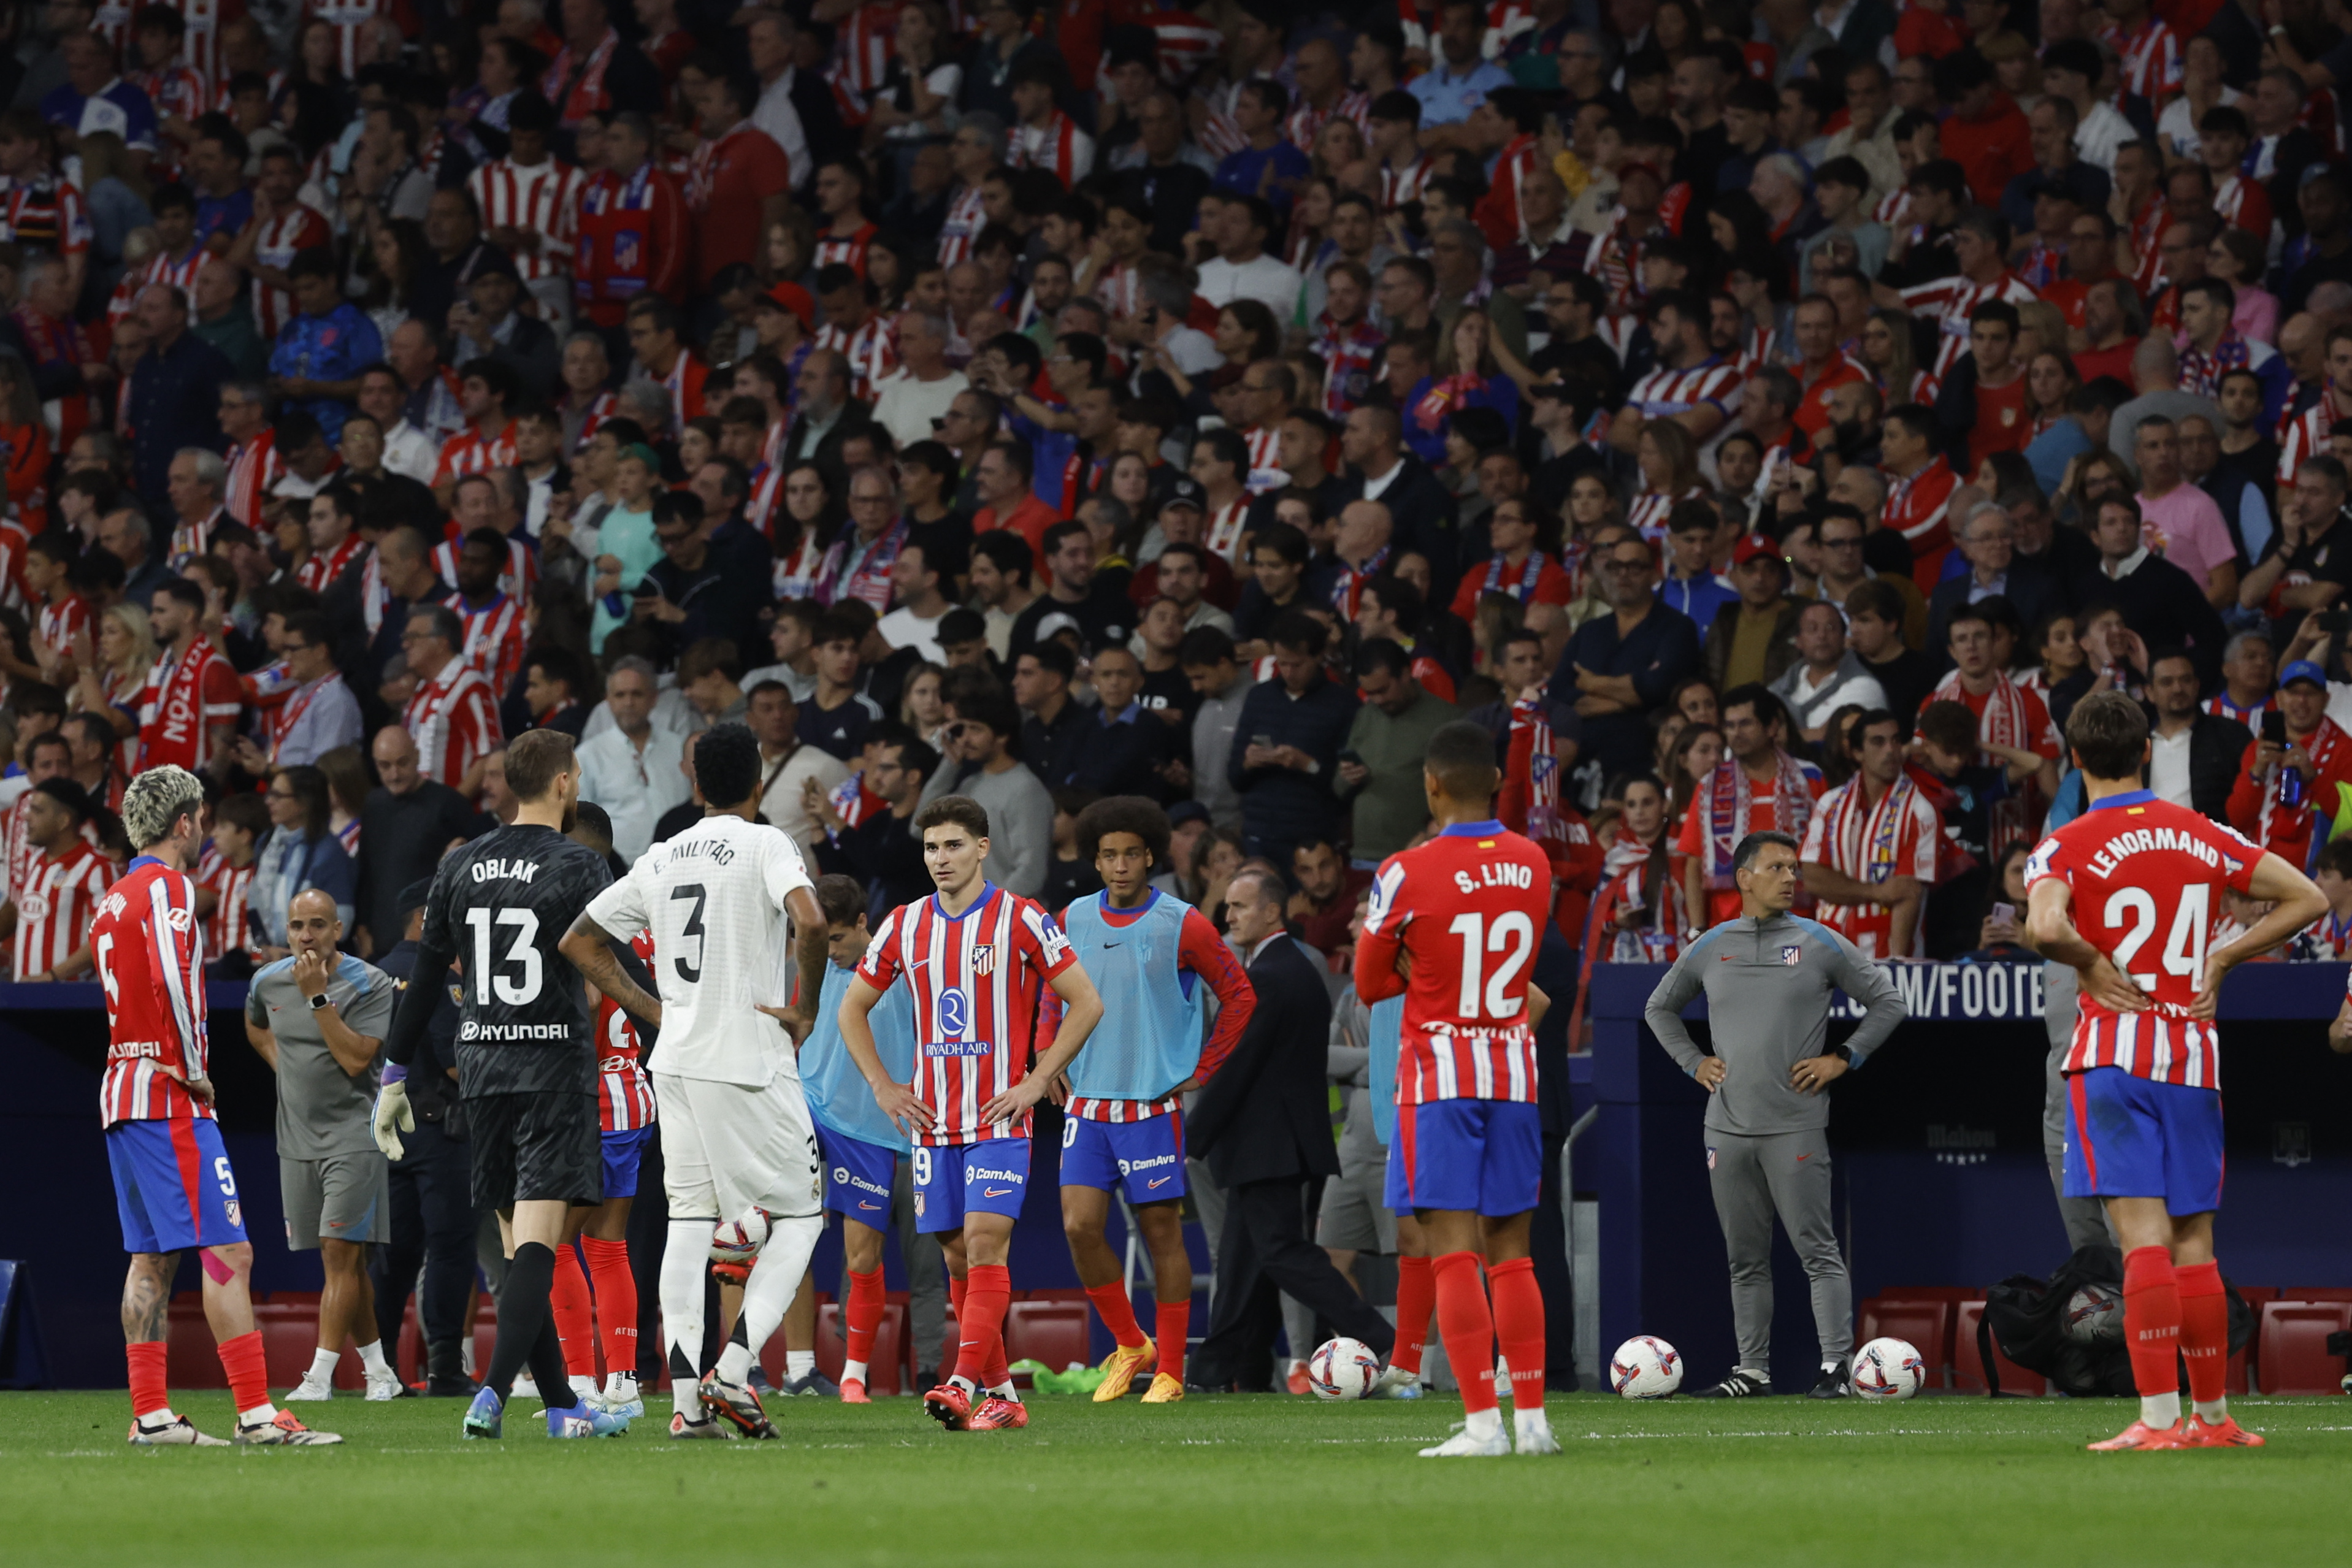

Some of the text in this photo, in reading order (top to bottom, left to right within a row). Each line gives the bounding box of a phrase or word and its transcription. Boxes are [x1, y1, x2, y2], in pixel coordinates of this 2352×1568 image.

[472, 859, 539, 884] OBLAK
[670, 883, 707, 983] 3
[2104, 882, 2210, 993] 24
[465, 908, 543, 1006] 13
[1448, 911, 1534, 1019] 12
[480, 1024, 569, 1041] HYUNDAI
[926, 1042, 988, 1056] RIYADH AIR
[214, 1157, 236, 1196] 5
[851, 1163, 890, 1198] ComAve
[976, 1168, 1023, 1184] ComAve
[1130, 1155, 1176, 1171] ComAve
